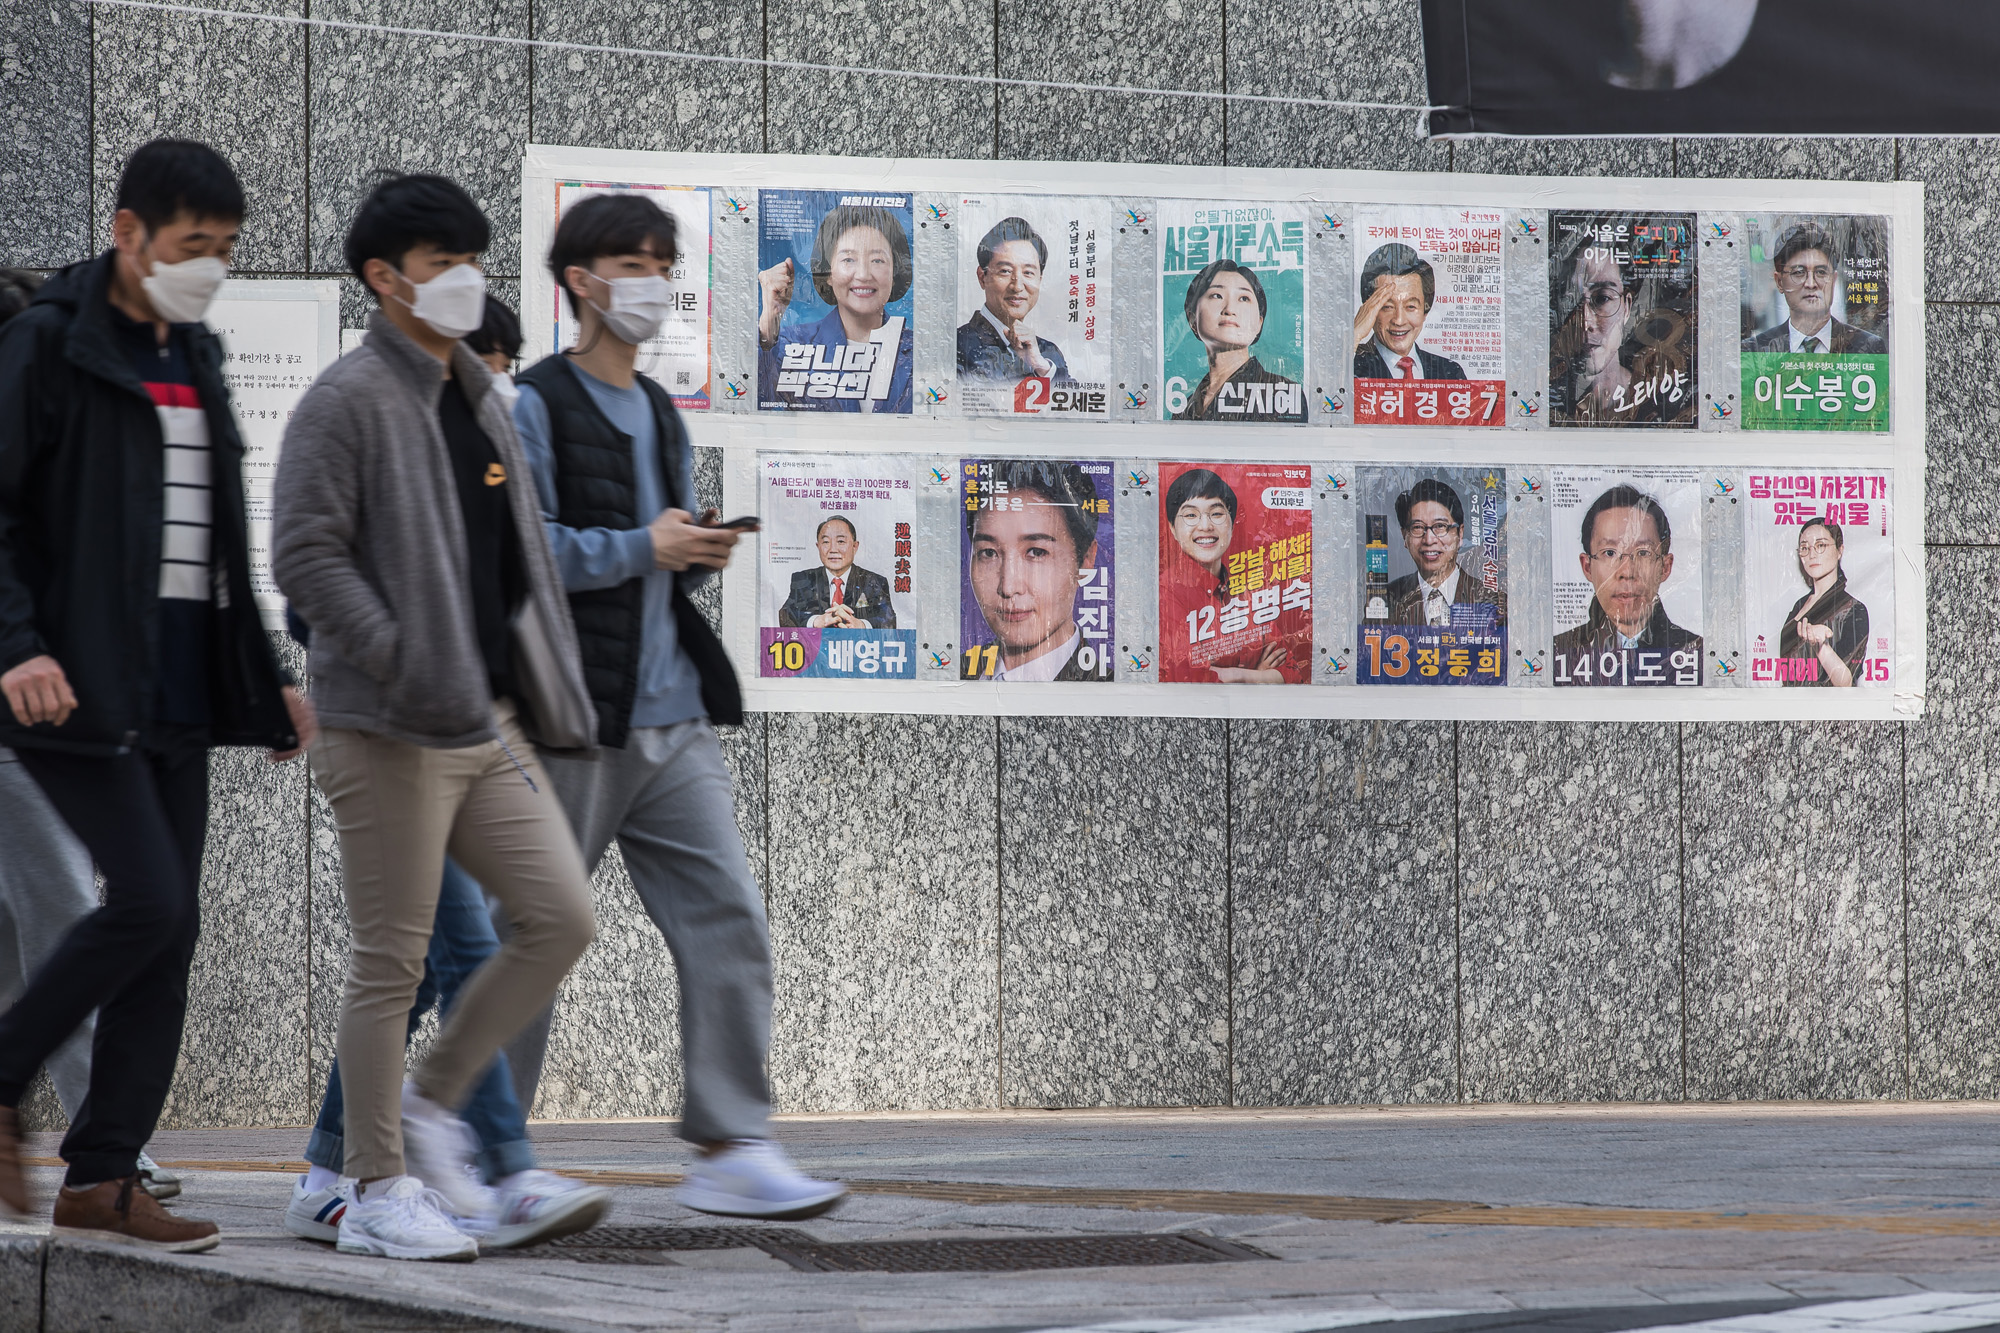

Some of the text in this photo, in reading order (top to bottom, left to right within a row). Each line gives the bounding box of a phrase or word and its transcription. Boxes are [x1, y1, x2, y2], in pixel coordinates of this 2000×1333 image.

[840, 196, 906, 208] 서울시 대전환
[1163, 221, 1304, 272] 서울기본소득
[1368, 226, 1502, 241] 국가에 돈이 없는 것이 아니라
[1418, 240, 1501, 254] 도둑놈이 많습니다
[1584, 224, 1630, 242] 서울은
[1085, 230, 1096, 279] 서울부터
[1432, 254, 1447, 263] 국가
[1584, 247, 1630, 265] 이기는
[1068, 220, 1080, 322] 첫날부터 능숙하게
[1446, 265, 1475, 274] 허경영이
[239, 353, 302, 364] 확인기간 등 공고
[869, 316, 905, 400] 1
[776, 372, 870, 399] 박영선
[1026, 379, 1043, 411] 2
[1165, 376, 1188, 414] 6
[1218, 382, 1302, 415] 신지혜
[1612, 369, 1689, 413] 오태양
[1754, 374, 1847, 413] 이수봉
[1851, 374, 1877, 413] 9
[1051, 392, 1106, 413] 오세훈
[1380, 390, 1471, 419] 허경영
[1480, 391, 1499, 421] 7
[847, 479, 862, 488] 공원
[964, 463, 994, 478] 여자
[825, 489, 842, 500] 조성,
[1270, 497, 1305, 507] 지지후보
[1749, 475, 1887, 500] 당신의 자리가
[1081, 498, 1110, 513] 서울
[1482, 495, 1498, 560] 서울 경제
[1228, 546, 1266, 574] 강남
[1228, 566, 1264, 596] 평등
[1219, 578, 1311, 635] 송명숙
[1077, 566, 1110, 677] 김진아
[1186, 605, 1216, 644] 12
[768, 641, 805, 671] 10
[828, 640, 907, 674] 배영규
[965, 645, 999, 676] 11
[1364, 634, 1410, 677] 13
[1416, 648, 1501, 677] 정동희
[1554, 654, 1593, 682] 14
[1599, 650, 1699, 686] 이도엽
[1864, 658, 1890, 682] 15
